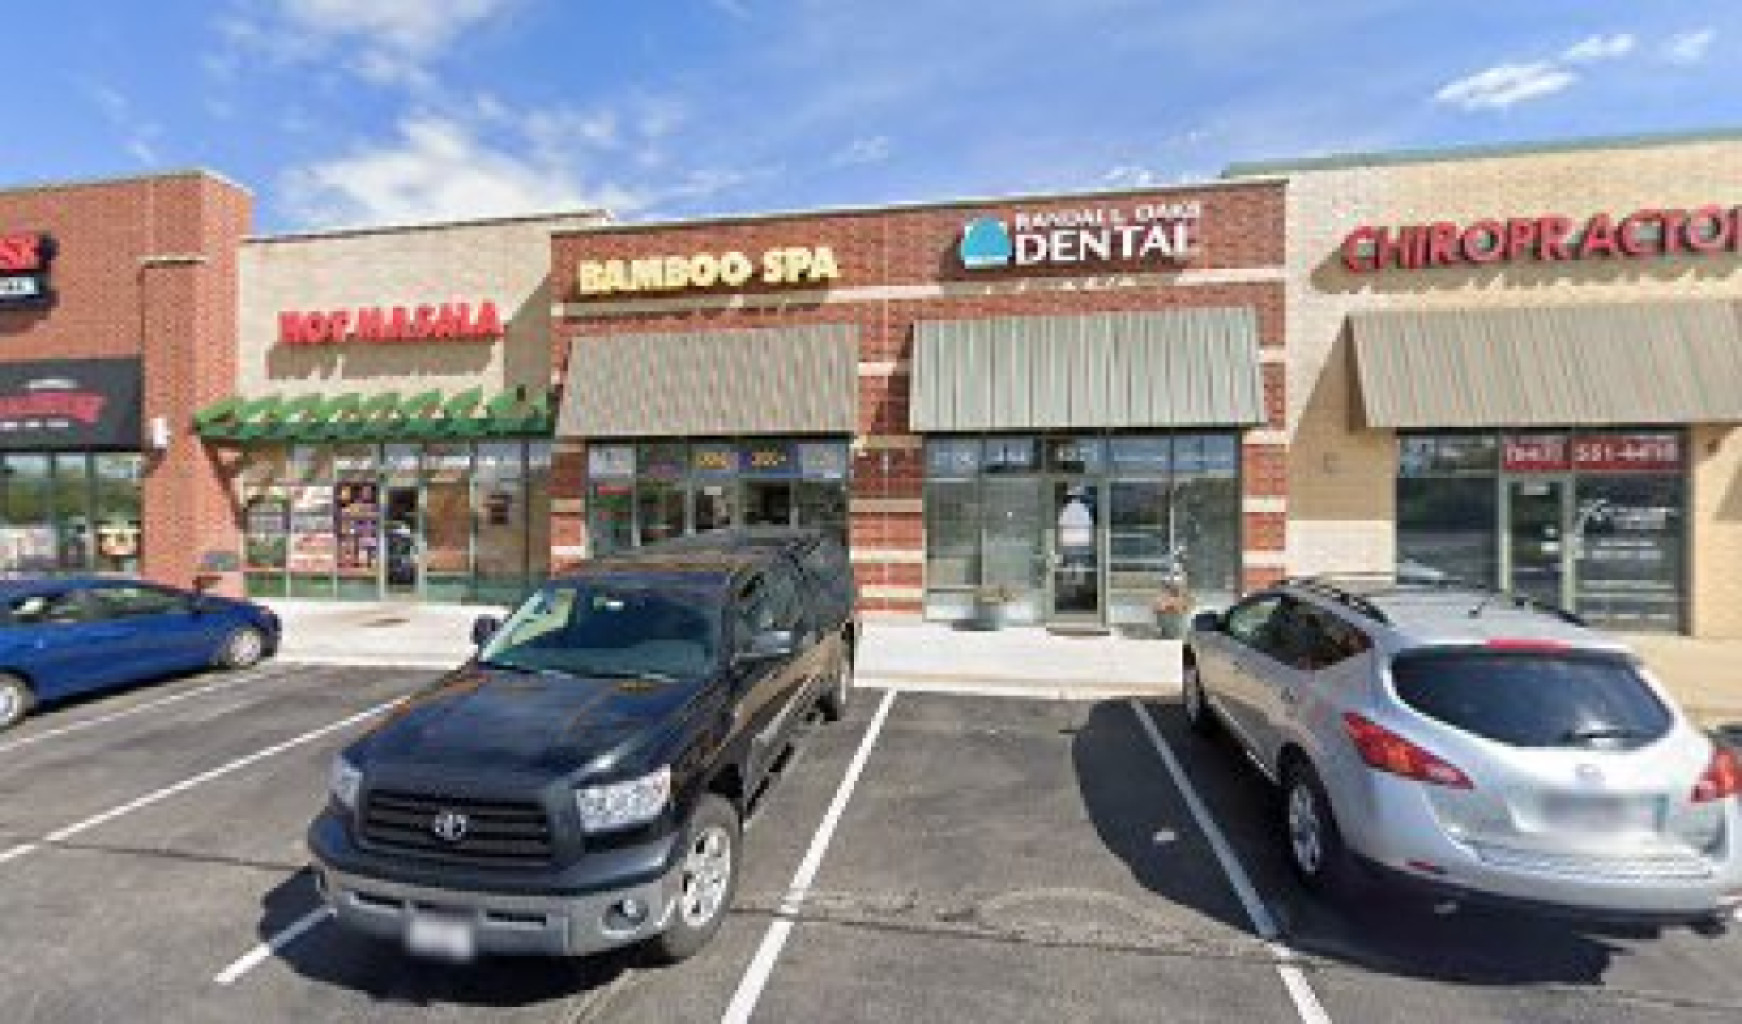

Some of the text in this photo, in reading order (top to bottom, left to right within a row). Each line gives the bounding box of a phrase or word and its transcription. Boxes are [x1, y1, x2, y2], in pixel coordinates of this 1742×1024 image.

[1015, 222, 1196, 265] DENTAL
[579, 245, 839, 295] BAMBOO SPA
[279, 300, 505, 343] HOT MASALA
